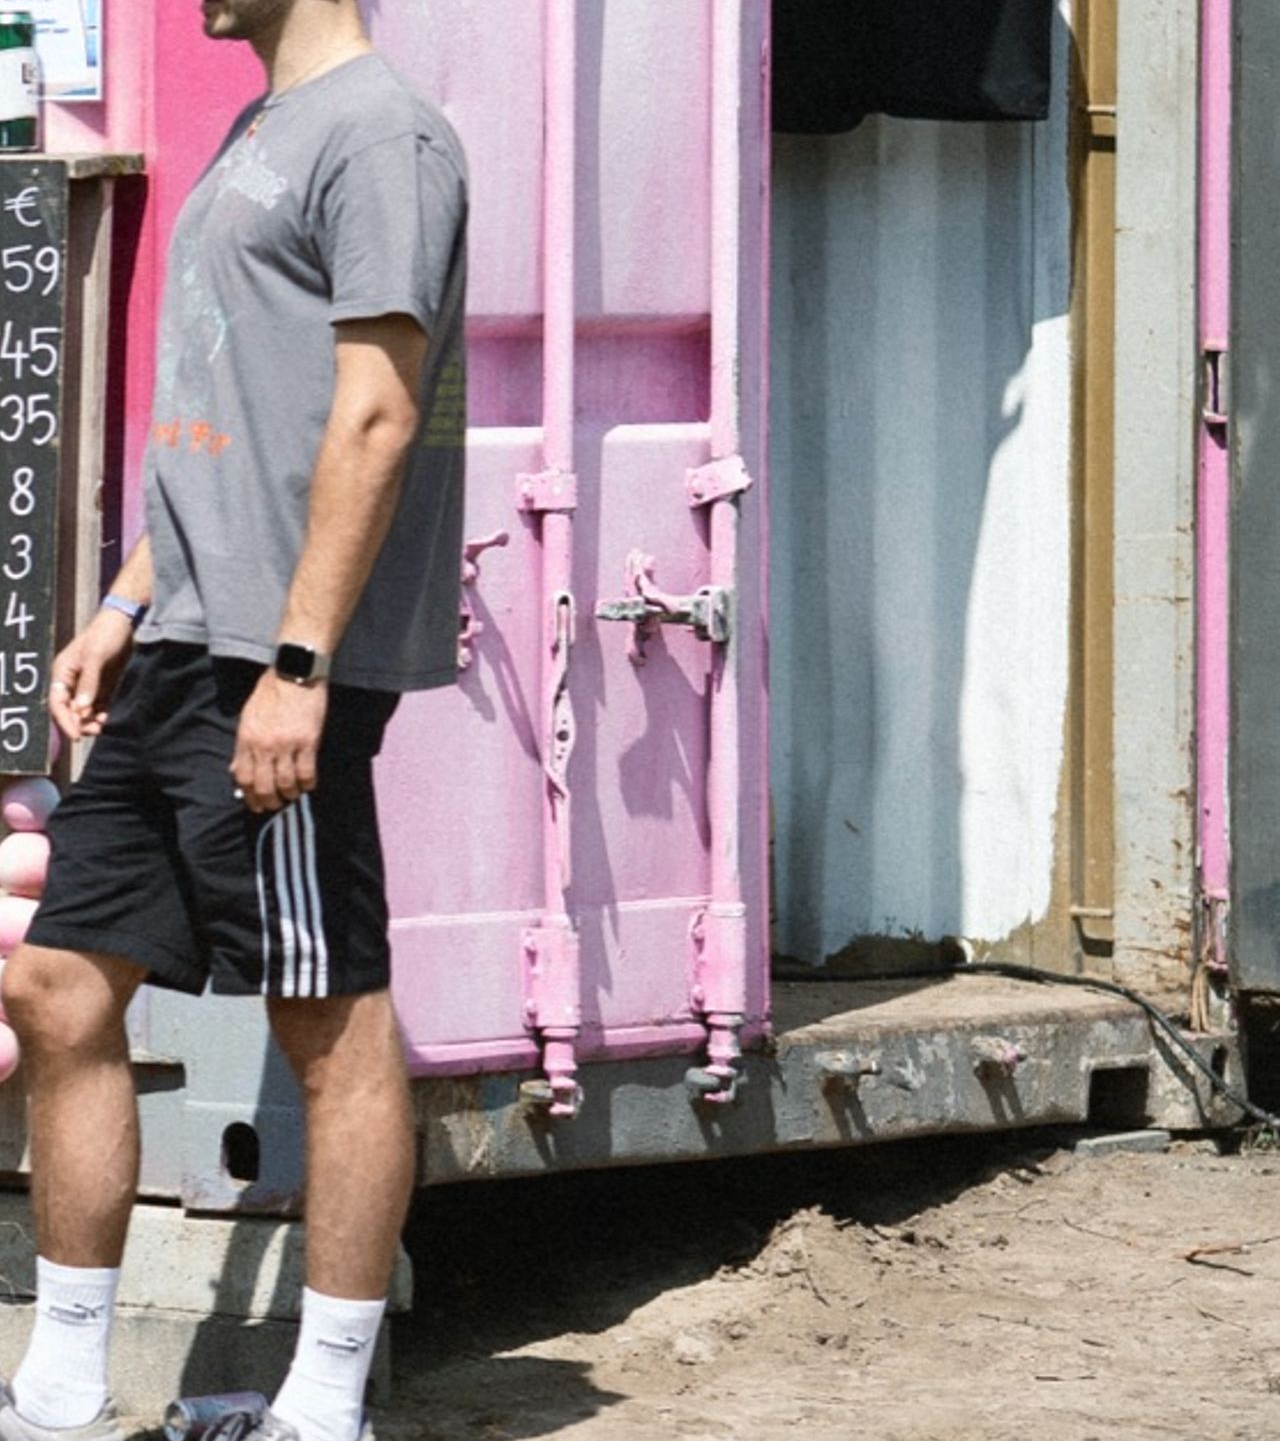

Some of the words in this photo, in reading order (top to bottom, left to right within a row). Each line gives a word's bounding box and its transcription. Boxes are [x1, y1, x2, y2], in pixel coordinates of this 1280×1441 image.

[4, 186, 41, 227] €
[1, 244, 60, 296] 59
[0, 320, 60, 379] 45
[9, 466, 35, 516] 8
[2, 533, 32, 580] 3
[4, 591, 35, 639] 4
[0, 706, 29, 753] 5
